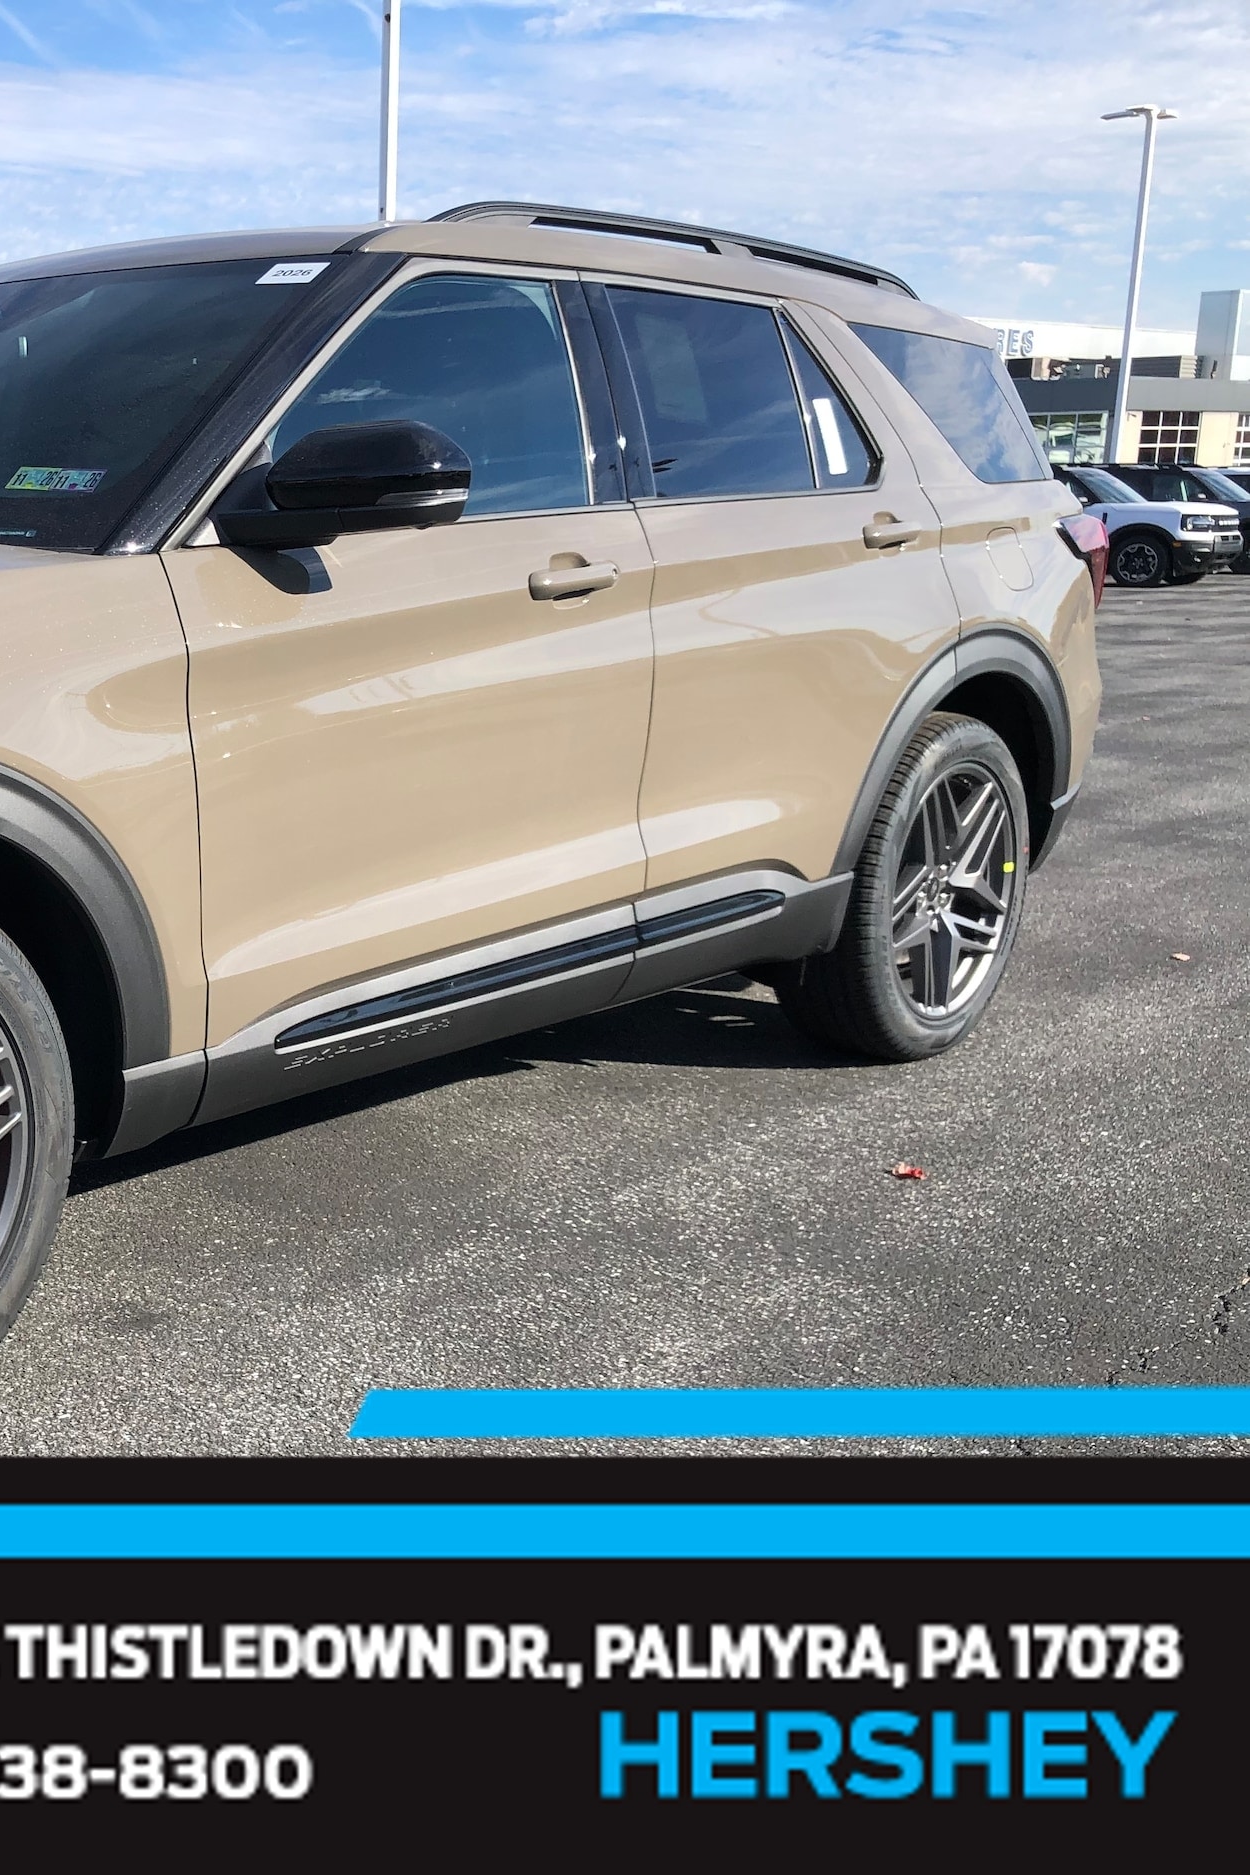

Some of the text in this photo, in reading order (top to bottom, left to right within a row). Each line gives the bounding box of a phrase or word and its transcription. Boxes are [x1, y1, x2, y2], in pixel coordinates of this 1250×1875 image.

[272, 269, 313, 277] 2026
[12, 471, 58, 486] 11 26
[54, 473, 102, 489] 11 26
[283, 1018, 451, 1070] EXPLORER
